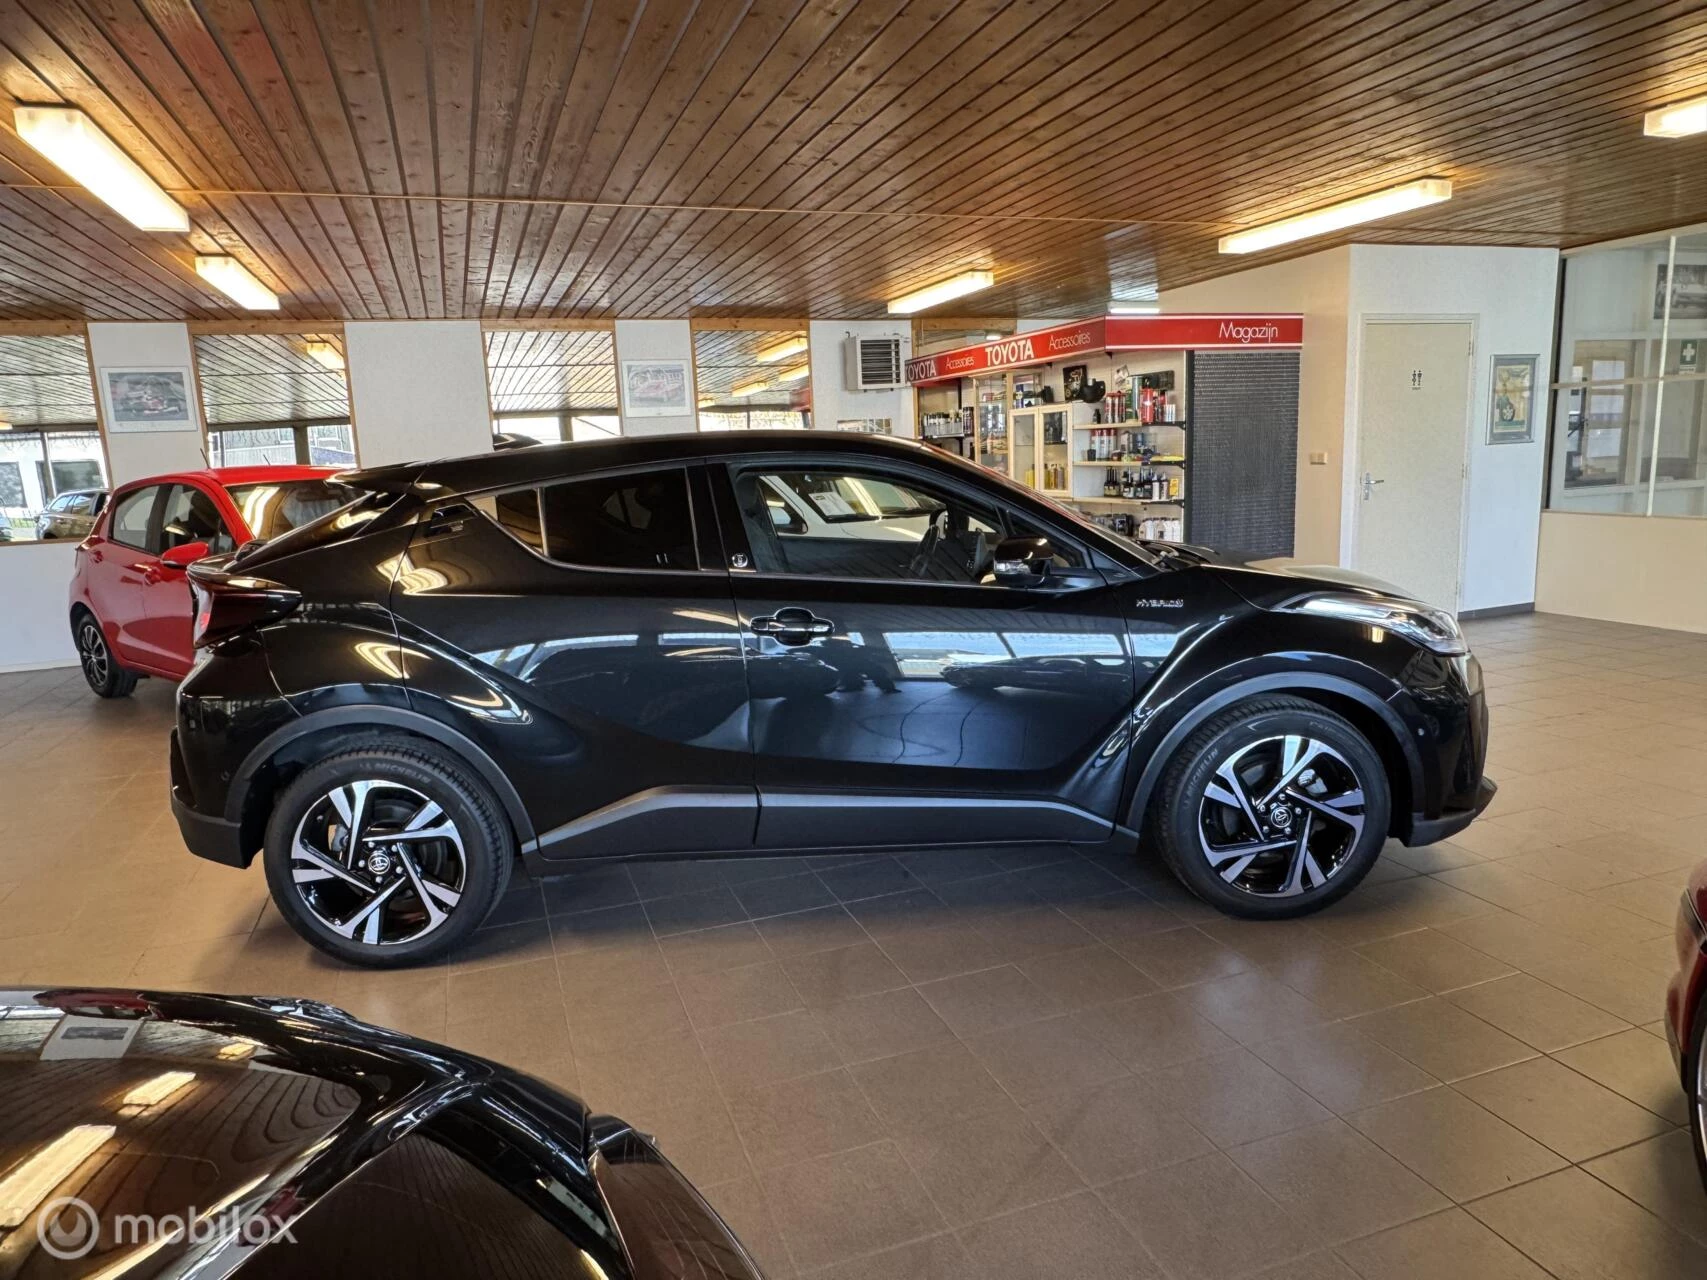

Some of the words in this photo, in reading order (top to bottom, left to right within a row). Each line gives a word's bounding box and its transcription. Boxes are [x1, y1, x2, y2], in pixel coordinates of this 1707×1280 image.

[1219, 321, 1278, 343] Magazijn
[946, 353, 975, 371] Accessoires
[985, 339, 1034, 366] TOYOTA
[1049, 331, 1091, 352] Accessoires
